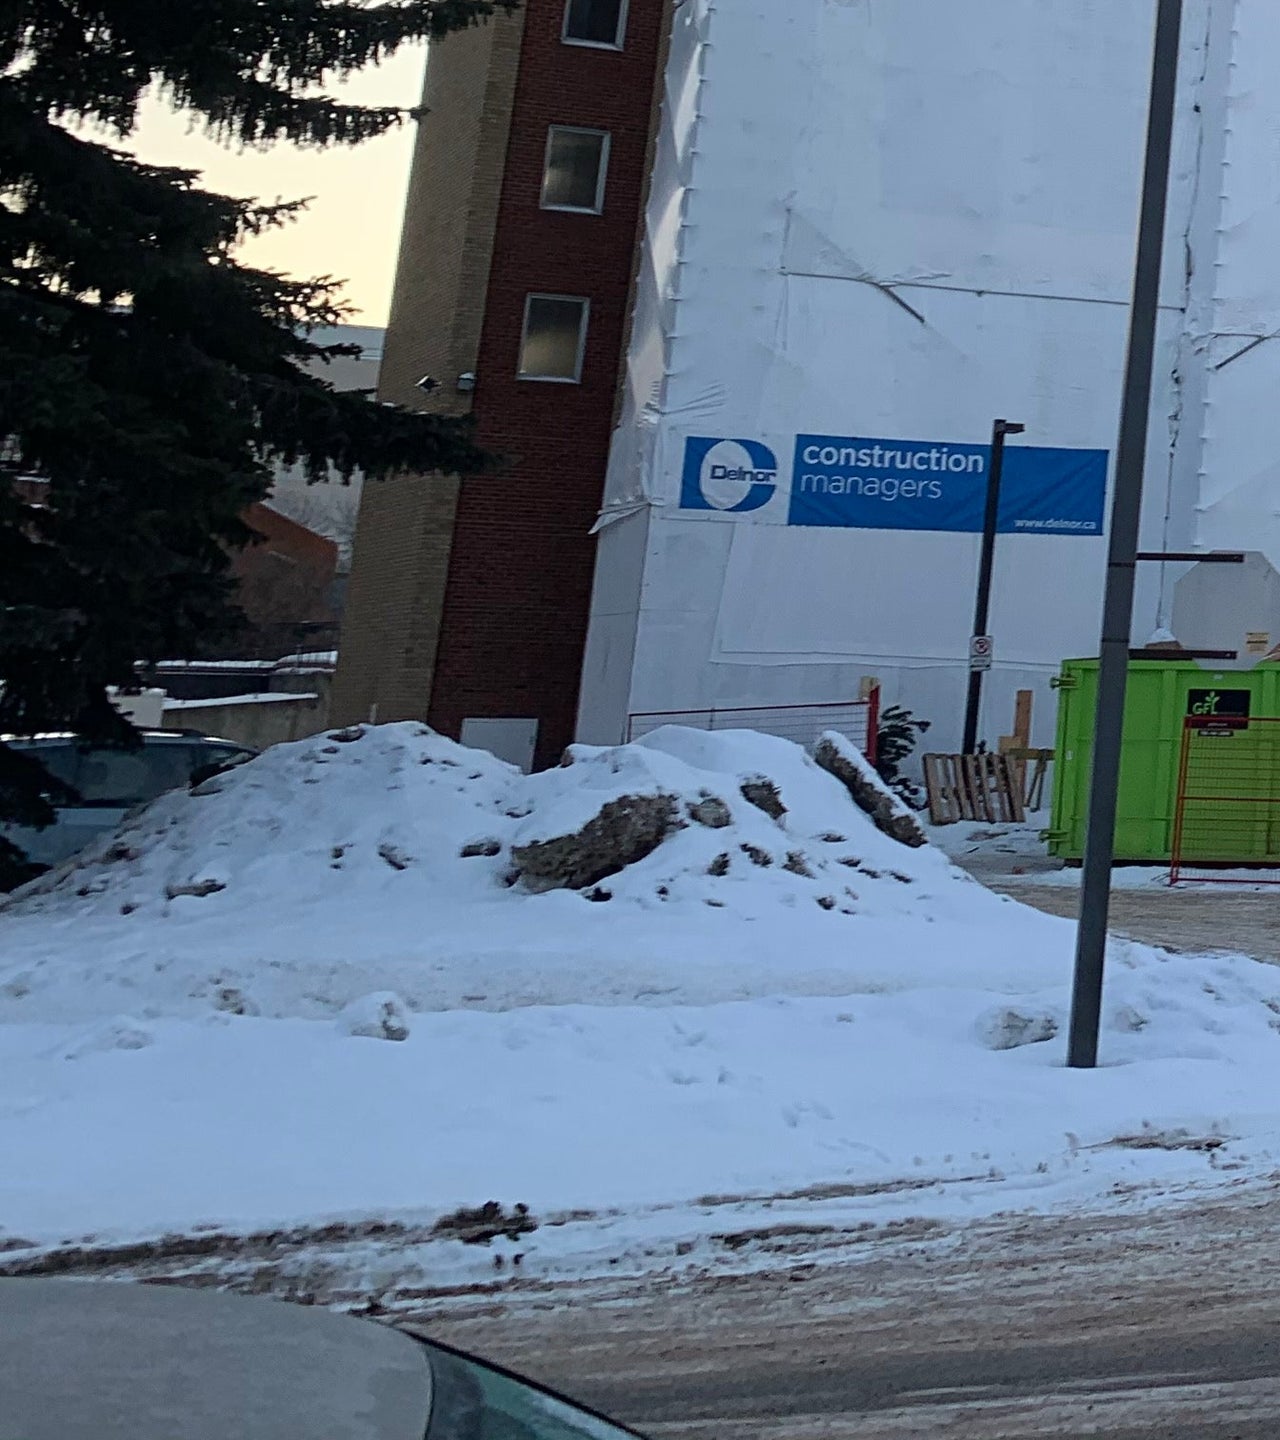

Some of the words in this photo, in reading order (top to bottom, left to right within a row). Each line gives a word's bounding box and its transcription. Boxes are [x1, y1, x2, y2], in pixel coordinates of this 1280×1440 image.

[709, 463, 776, 483] Delnor
[802, 443, 985, 475] construction
[800, 472, 943, 502] managers
